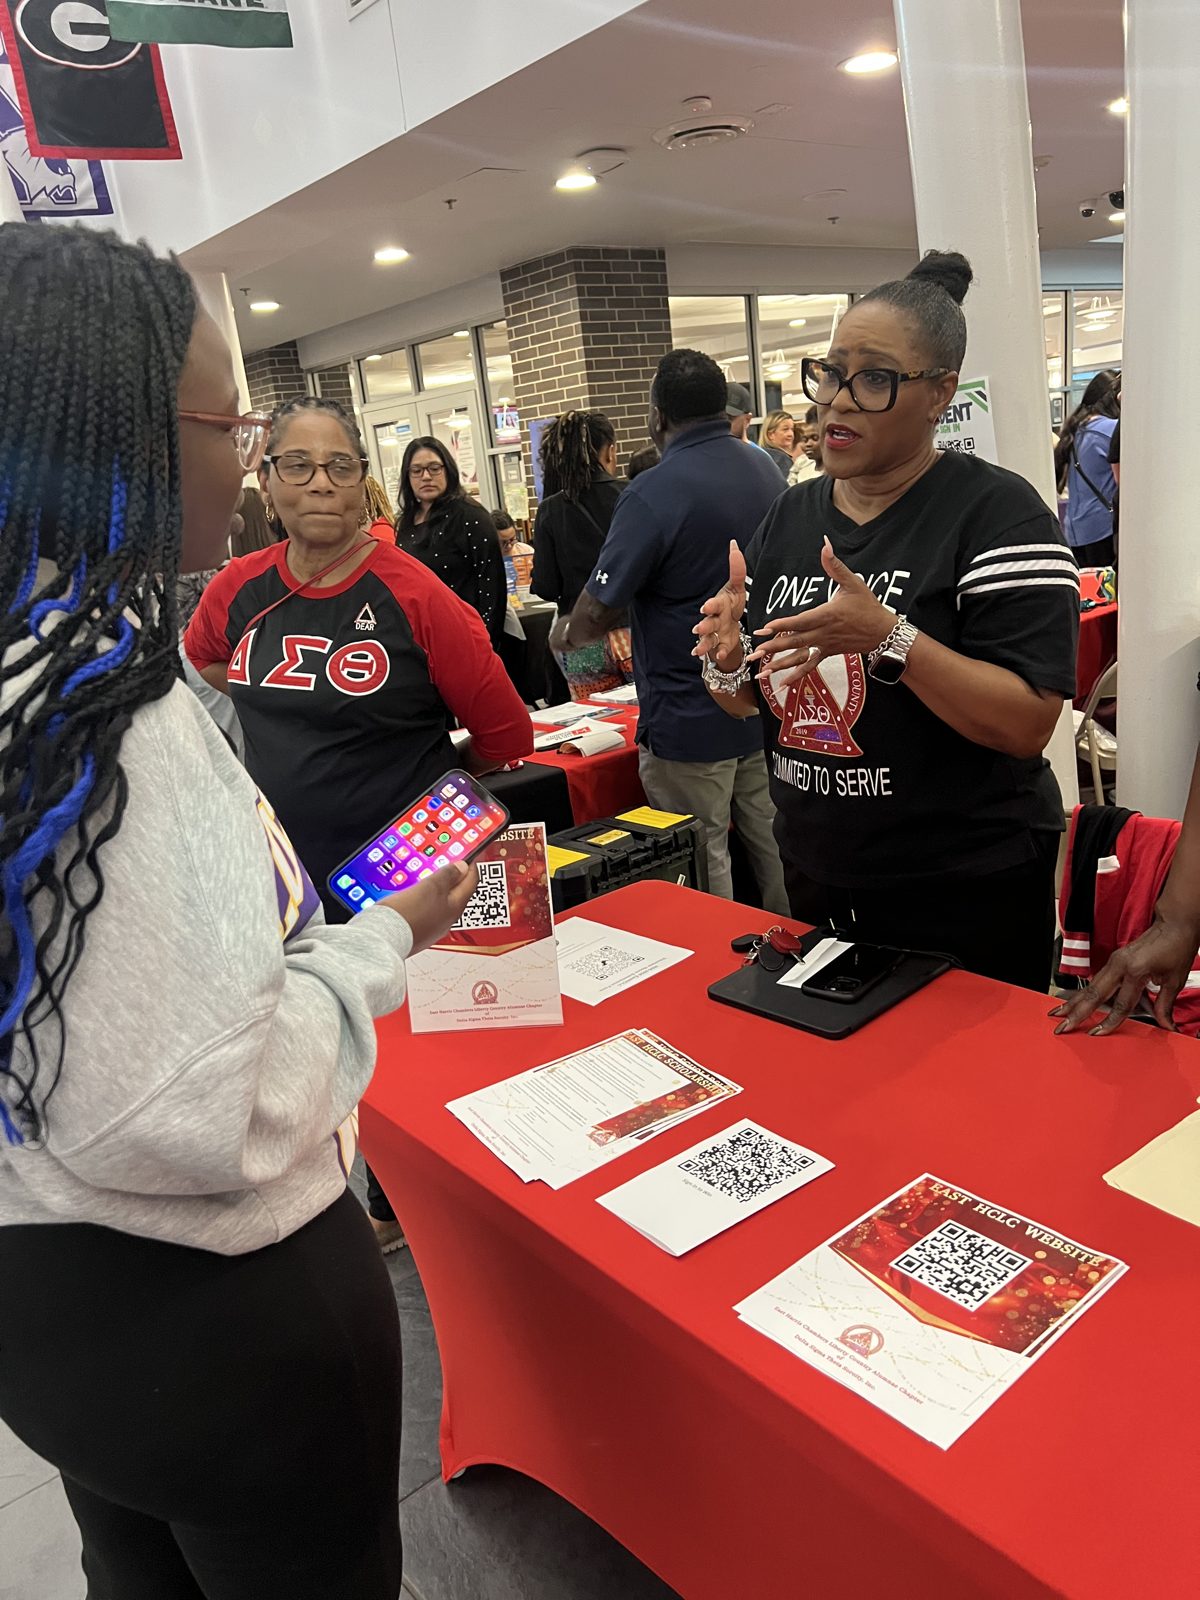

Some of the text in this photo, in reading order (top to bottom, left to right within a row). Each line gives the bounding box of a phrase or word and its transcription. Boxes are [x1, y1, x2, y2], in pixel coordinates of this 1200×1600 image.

[766, 574, 825, 614] ONE
[355, 622, 375, 631] DEAR
[814, 766, 830, 795] TO
[836, 768, 892, 796] SERVE
[624, 1032, 645, 1046] EAST
[642, 1043, 667, 1060] HCLC
[928, 1182, 1106, 1267] EAST HCLC WEBSITE
